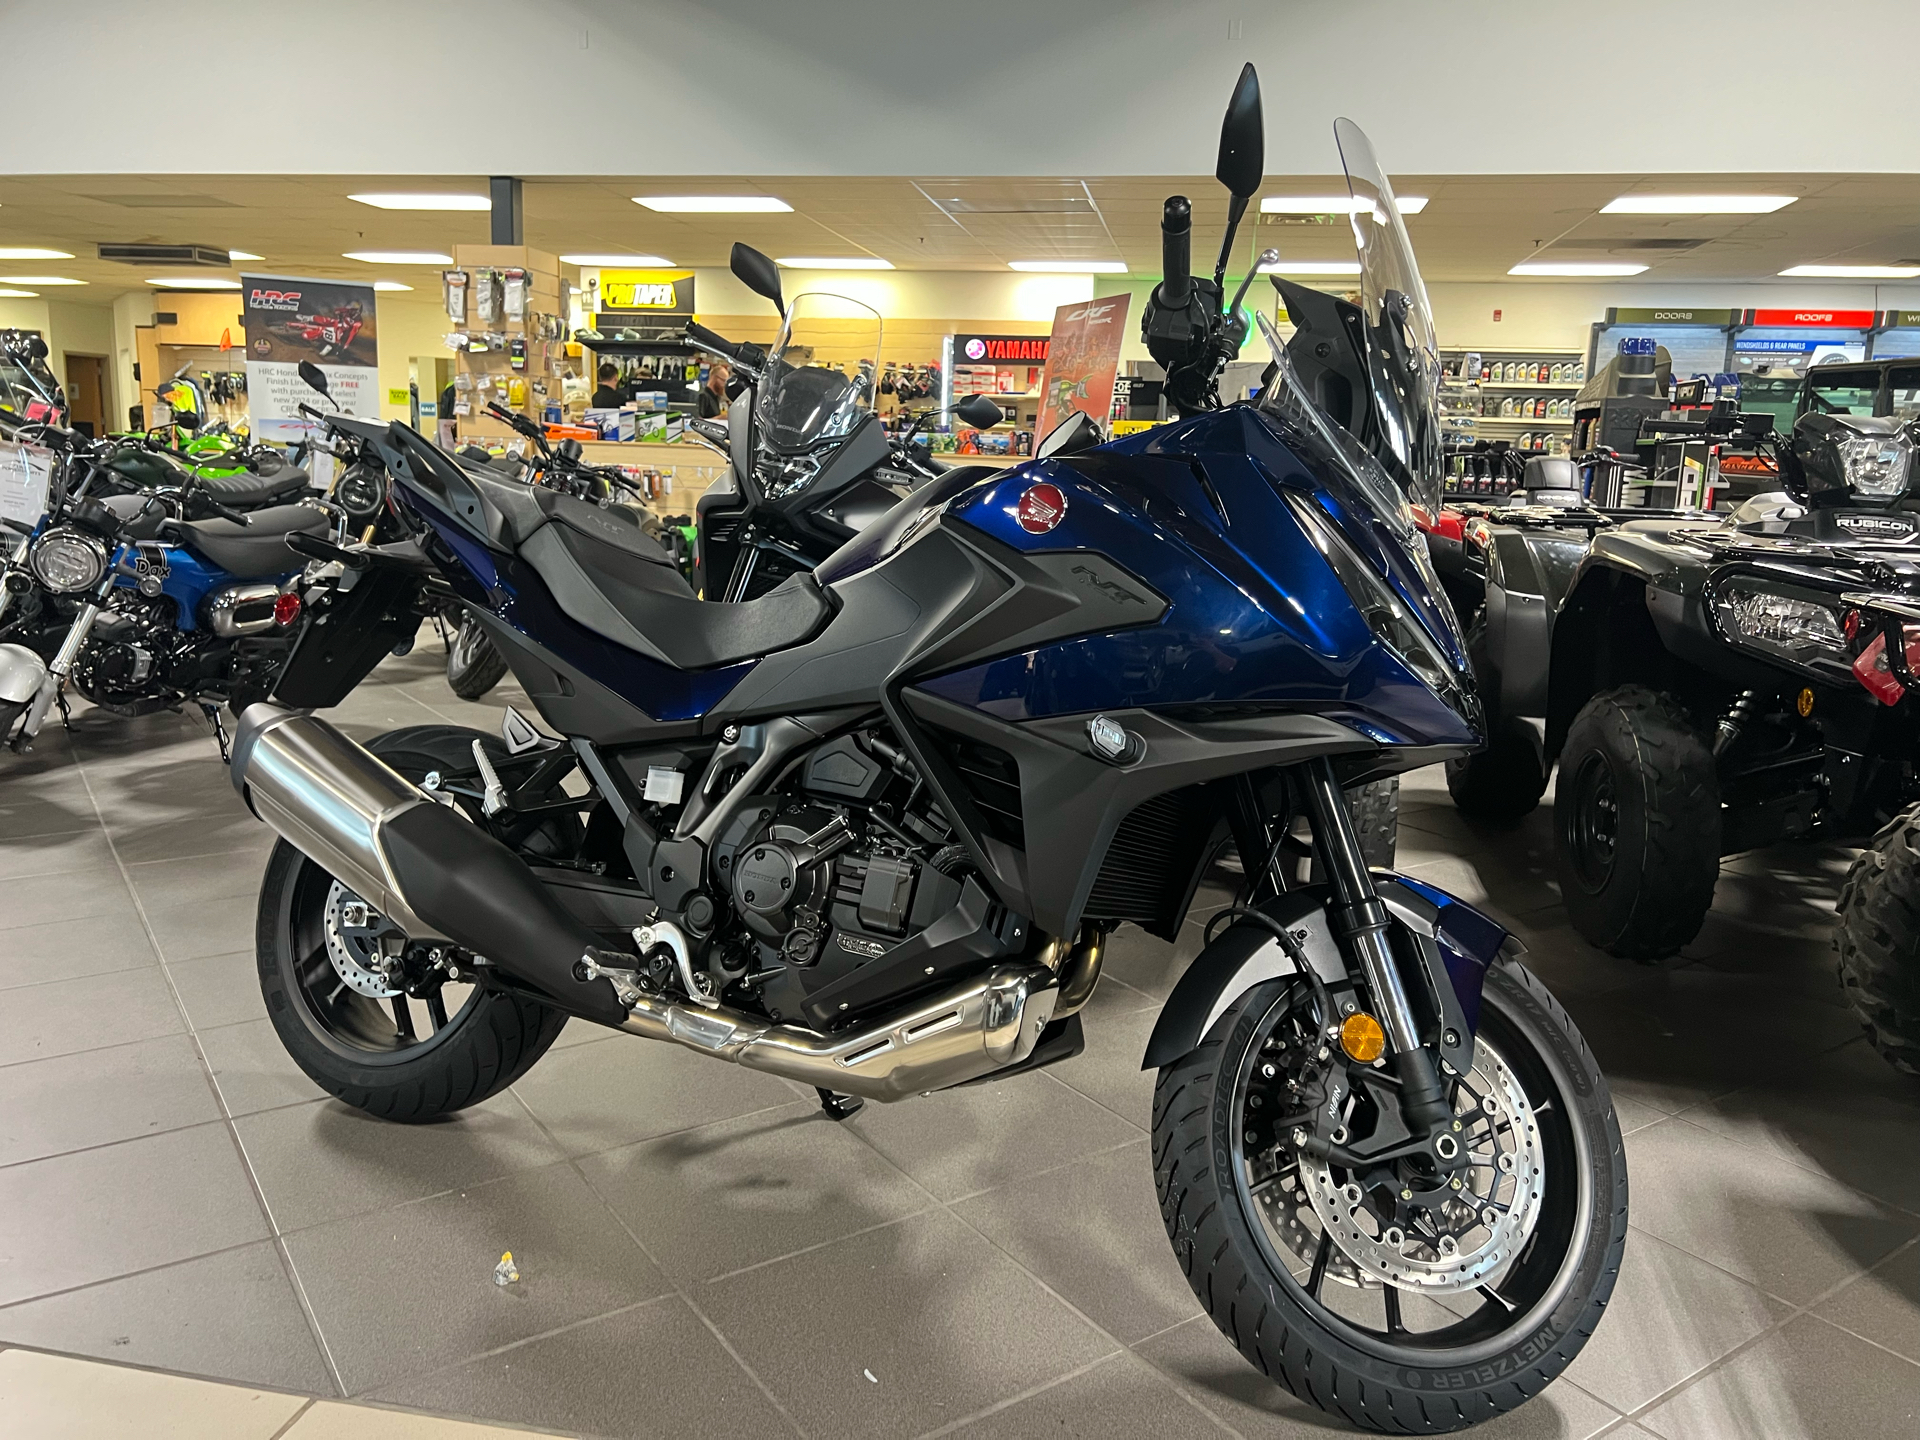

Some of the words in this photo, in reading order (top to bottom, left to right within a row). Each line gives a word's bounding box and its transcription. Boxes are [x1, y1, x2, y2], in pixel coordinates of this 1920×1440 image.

[250, 289, 301, 306] HRC
[1065, 304, 1116, 322] CRF
[1655, 312, 1692, 320] DOORS
[1795, 314, 1833, 322] ROOFS
[258, 368, 275, 376] HRC
[276, 369, 299, 377] Hond
[334, 372, 369, 381] Concepts
[266, 377, 289, 386] Finish
[341, 400, 357, 408] year
[1836, 519, 1914, 533] RUBICON
[135, 557, 171, 579] Dax
[743, 870, 777, 885] HONDA
[1214, 1064, 1234, 1190] ROADTEC
[1431, 1326, 1558, 1389] METZELER
